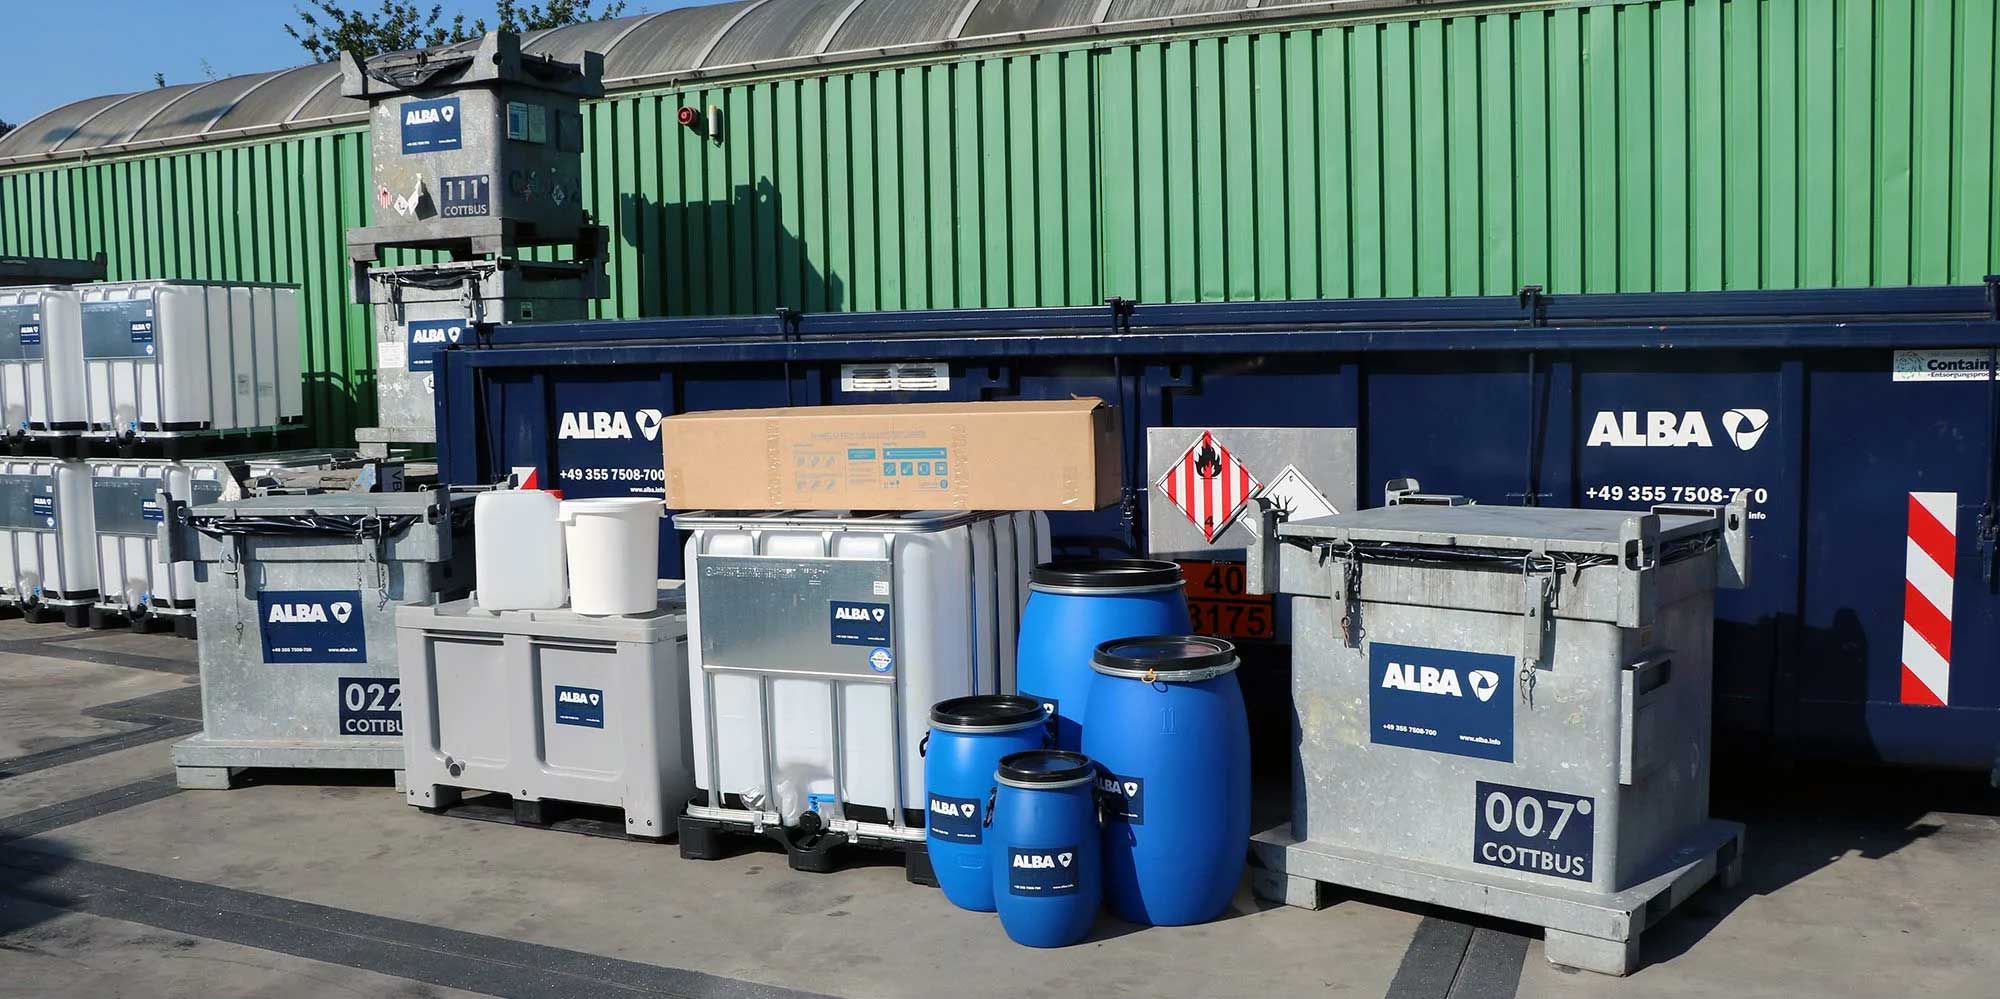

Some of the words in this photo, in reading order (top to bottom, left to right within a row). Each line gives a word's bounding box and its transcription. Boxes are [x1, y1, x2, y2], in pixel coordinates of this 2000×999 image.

[406, 108, 440, 126] ALBA
[444, 204, 487, 216] COTTBUS
[412, 328, 447, 343] ALBA
[1927, 359, 1999, 371] Contain
[558, 411, 633, 439] ALBA
[1586, 411, 1713, 447] ALBA
[560, 468, 583, 481] +49
[585, 468, 609, 481] 355
[611, 468, 665, 481] 7508-700
[1586, 485, 1624, 501] +49
[1628, 486, 1667, 502] 355
[1671, 487, 1768, 504] 7508-70
[1204, 515, 1214, 527] 4
[1203, 565, 1245, 595] 40
[268, 603, 328, 622] ALBA
[835, 607, 870, 621] ALBA
[1381, 662, 1463, 697] ALBA
[345, 683, 401, 711] 022
[559, 691, 589, 705] ALBA
[345, 719, 403, 733] COTTBU
[1395, 725, 1408, 733] 355
[1459, 735, 1501, 746] www.alba.info
[931, 799, 960, 816] ALBA
[1013, 854, 1056, 869] ALBA
[1482, 842, 1585, 876] COTTBUS
